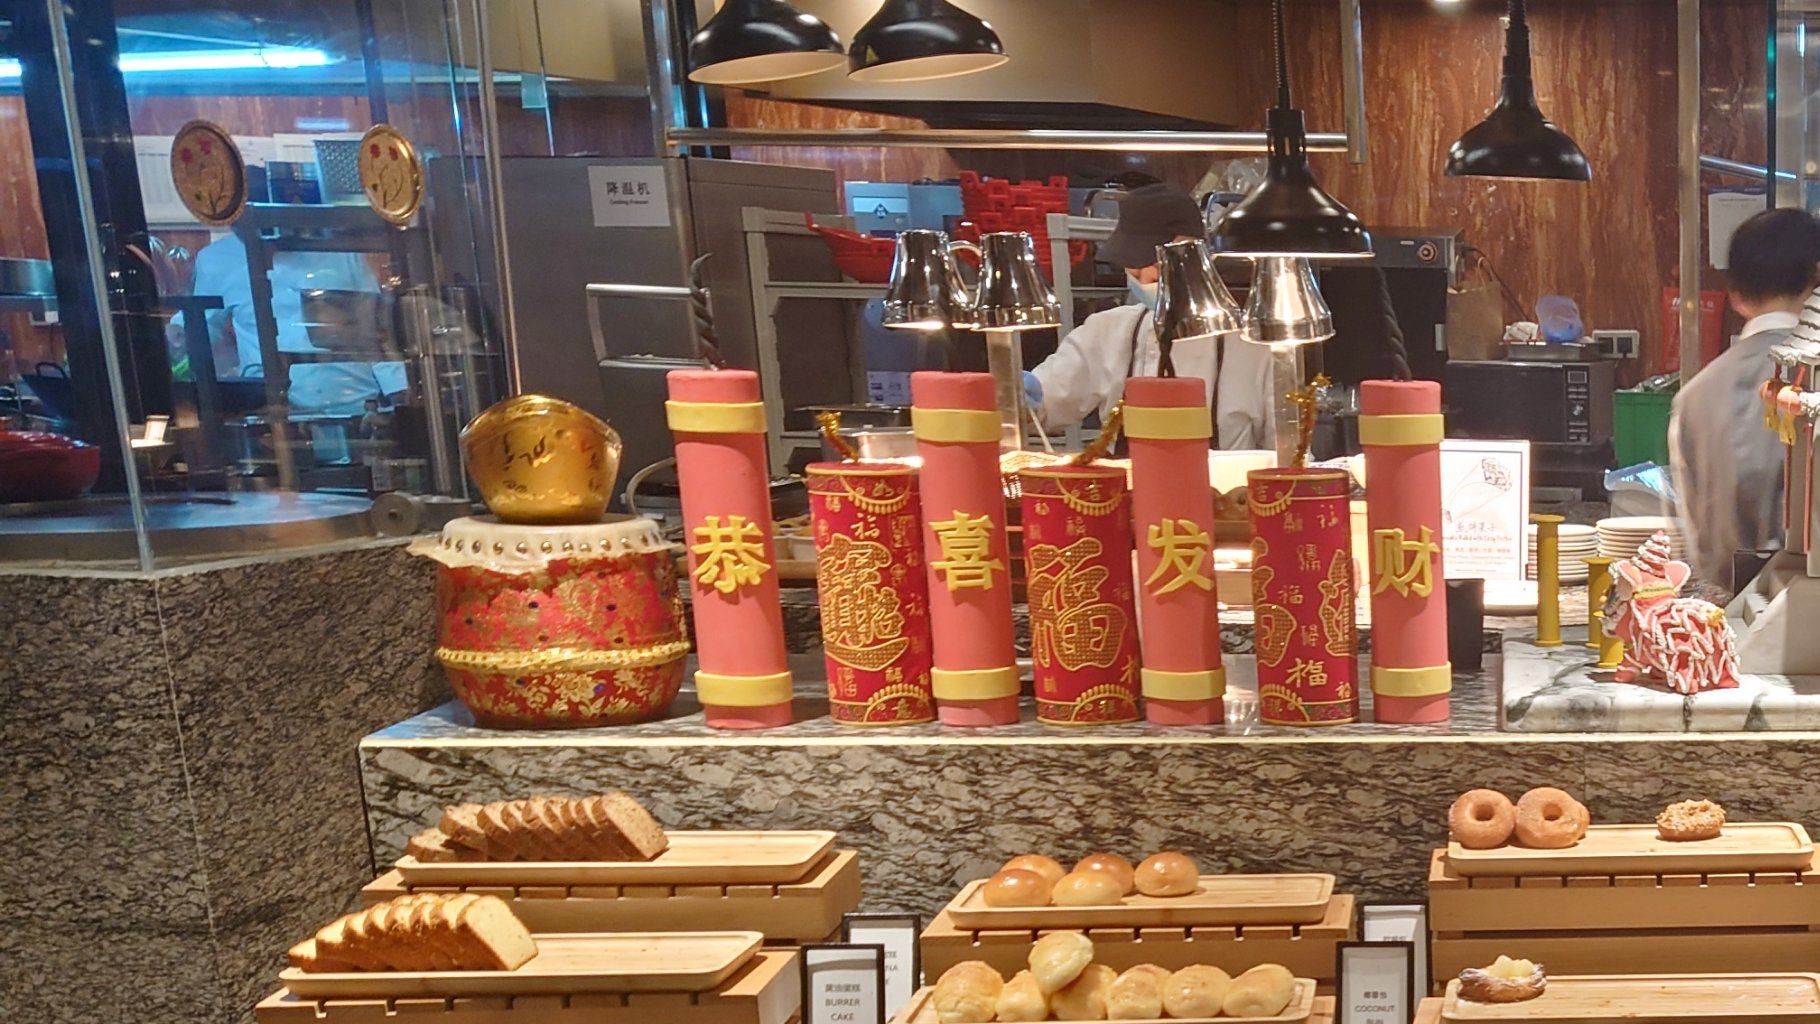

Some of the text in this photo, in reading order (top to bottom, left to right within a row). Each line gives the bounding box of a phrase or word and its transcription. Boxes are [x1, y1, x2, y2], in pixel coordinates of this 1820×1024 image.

[690, 515, 771, 594] 恭
[929, 510, 1004, 592] 喜
[1143, 518, 1214, 597] 发
[1372, 524, 1441, 598] 财
[1028, 536, 1128, 672] 福
[1286, 658, 1328, 688] 福
[831, 1013, 854, 1021] CAKE
[1354, 1005, 1395, 1013] COCONUT
